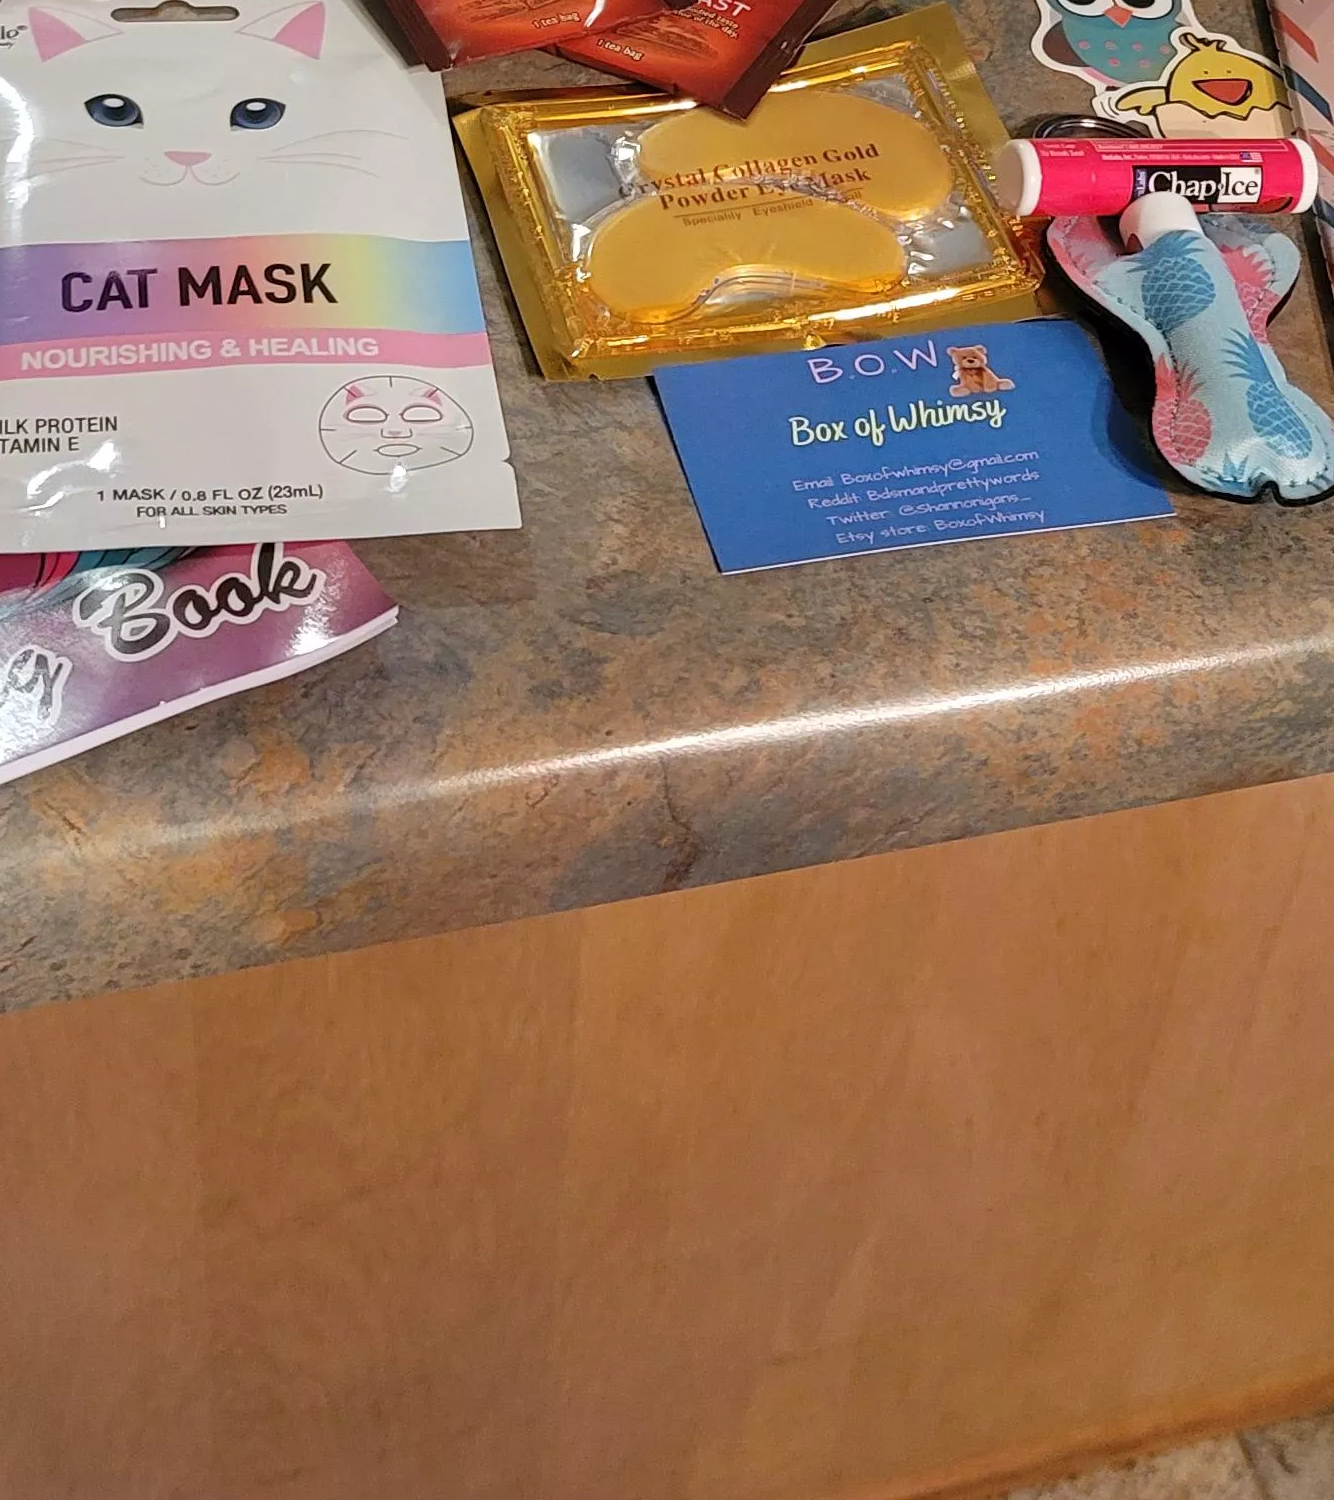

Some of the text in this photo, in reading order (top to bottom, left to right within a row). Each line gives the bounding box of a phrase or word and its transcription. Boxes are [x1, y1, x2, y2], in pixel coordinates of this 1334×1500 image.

[540, 15, 560, 27] tea
[559, 11, 582, 25] bag
[604, 40, 623, 53] tea
[623, 45, 645, 61] bag
[617, 142, 881, 199] Crystal Collagen Gold
[659, 183, 750, 211] Powder
[752, 197, 815, 217] Eyeshield
[61, 263, 339, 313] CAT MASK
[21, 337, 380, 371] NOURISHING & HEALING
[806, 339, 939, 385] B.O.W
[34, 415, 118, 435] PROTEIN
[788, 398, 1008, 447] Box of Whimsy
[67, 436, 80, 452] E
[840, 450, 1040, 486] Boxofwhimsy@gmail.com
[98, 484, 324, 502] 1 MASK / 0.8 FL OZ (23mL)
[865, 468, 1041, 503] Bdsmandprettywords
[136, 503, 288, 519] FOR ALL SKIN TYPES
[834, 530, 875, 545] Etsy
[932, 509, 1046, 532] BoxofWhimsy
[75, 542, 323, 660] Book
